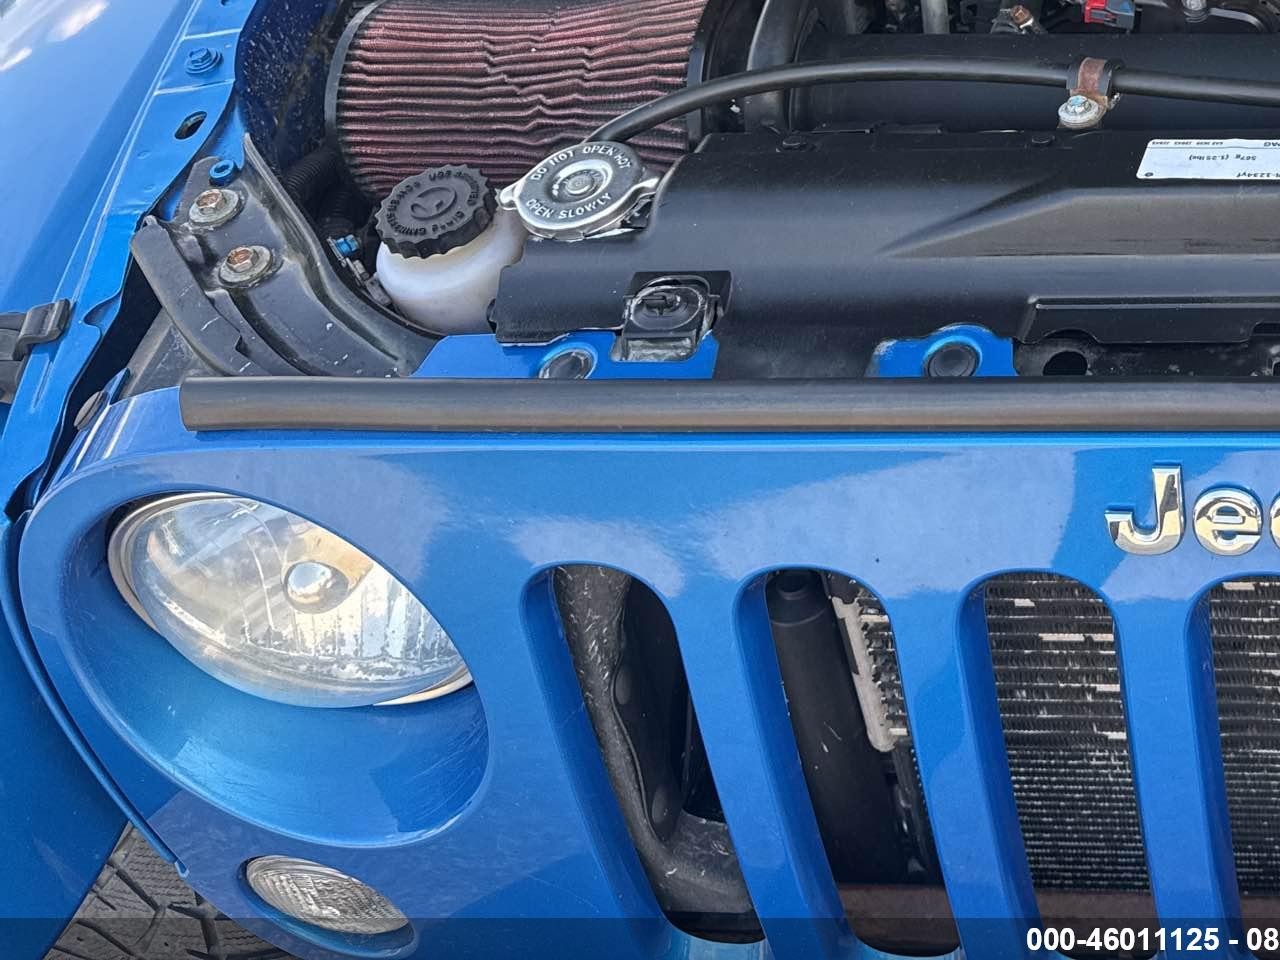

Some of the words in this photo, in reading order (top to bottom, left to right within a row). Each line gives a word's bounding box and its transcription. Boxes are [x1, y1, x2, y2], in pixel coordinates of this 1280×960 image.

[530, 166, 547, 181] DO
[550, 150, 575, 166] NOT
[582, 145, 616, 157] OPEN
[614, 152, 633, 169] HOT
[525, 198, 555, 219] OPEN
[558, 192, 612, 220] SLOWLY
